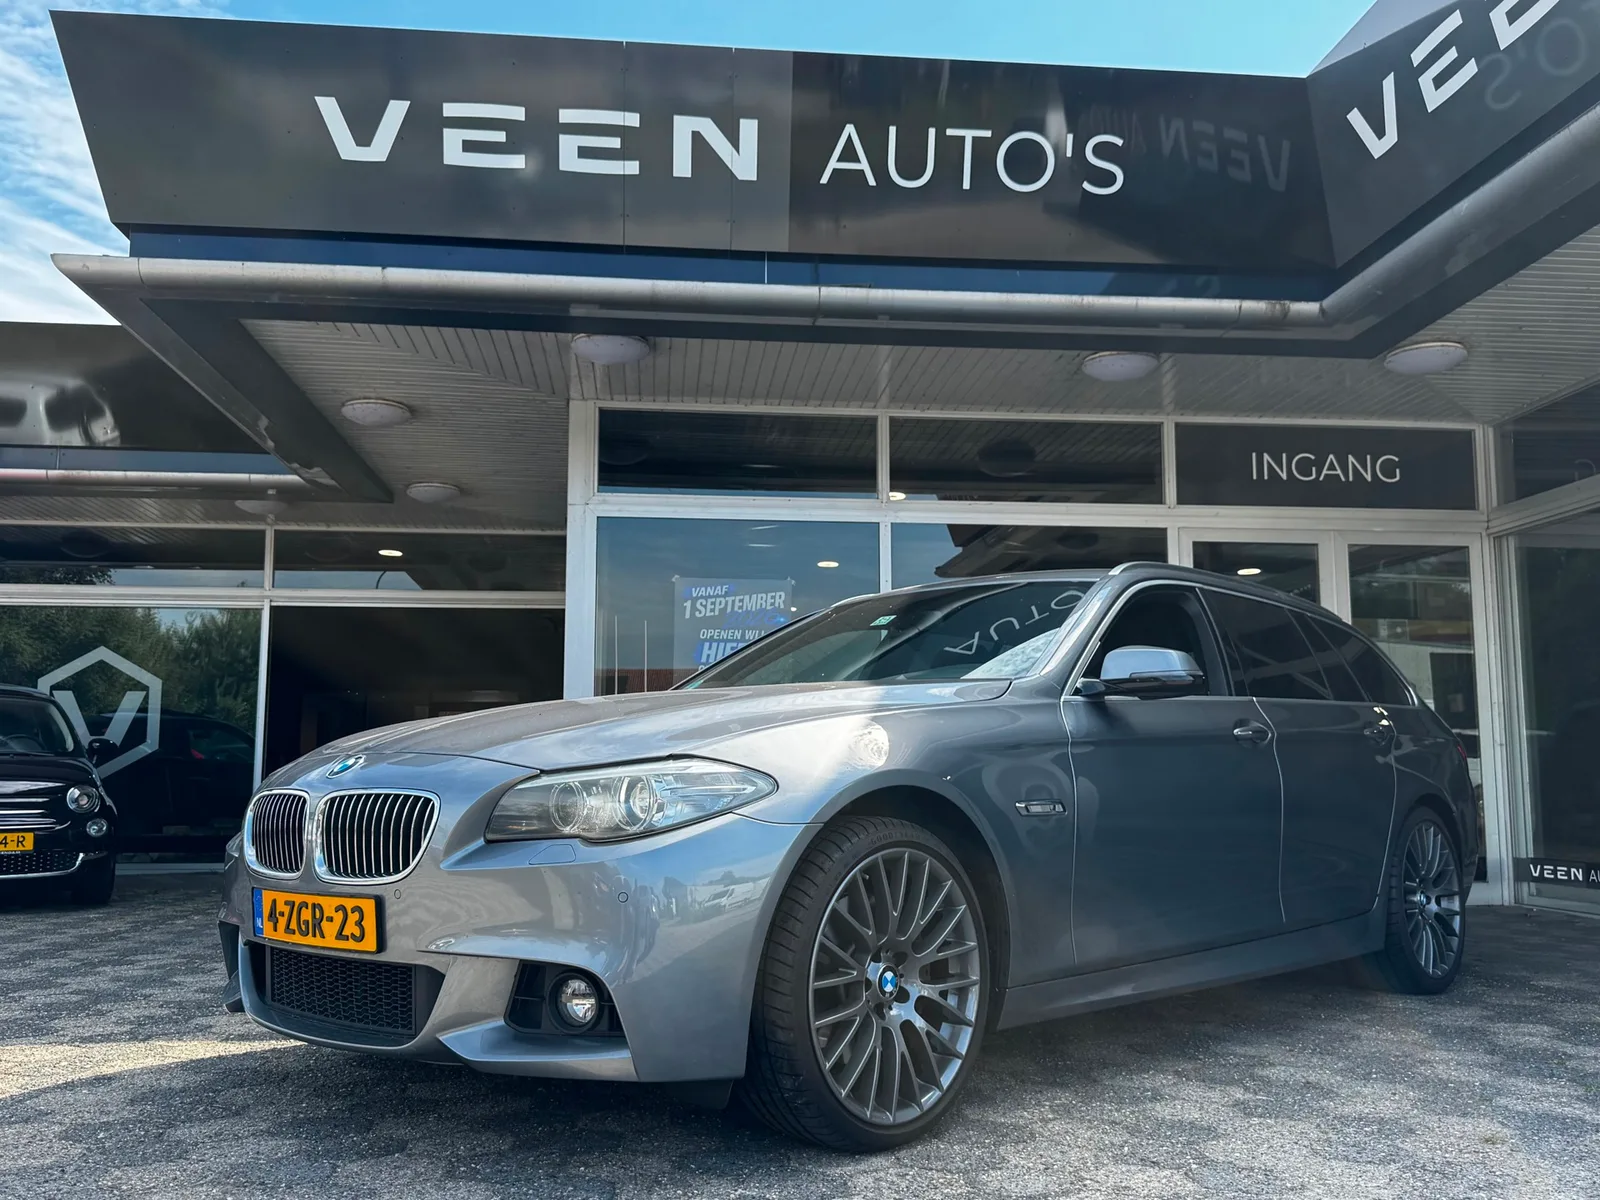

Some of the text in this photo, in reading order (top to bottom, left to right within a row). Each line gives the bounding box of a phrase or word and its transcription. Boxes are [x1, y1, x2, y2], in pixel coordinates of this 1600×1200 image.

[314, 96, 759, 182] VEEN
[819, 123, 1126, 196] AUTO'S
[1251, 452, 1401, 483] INGANG
[691, 585, 729, 597] VANAF
[683, 591, 786, 619] 1 SEPTEMBER
[700, 628, 742, 640] OPENEN
[700, 642, 746, 663] HIE
[1530, 864, 1583, 881] VEEN
[267, 898, 366, 943] 4-ZGR-23
